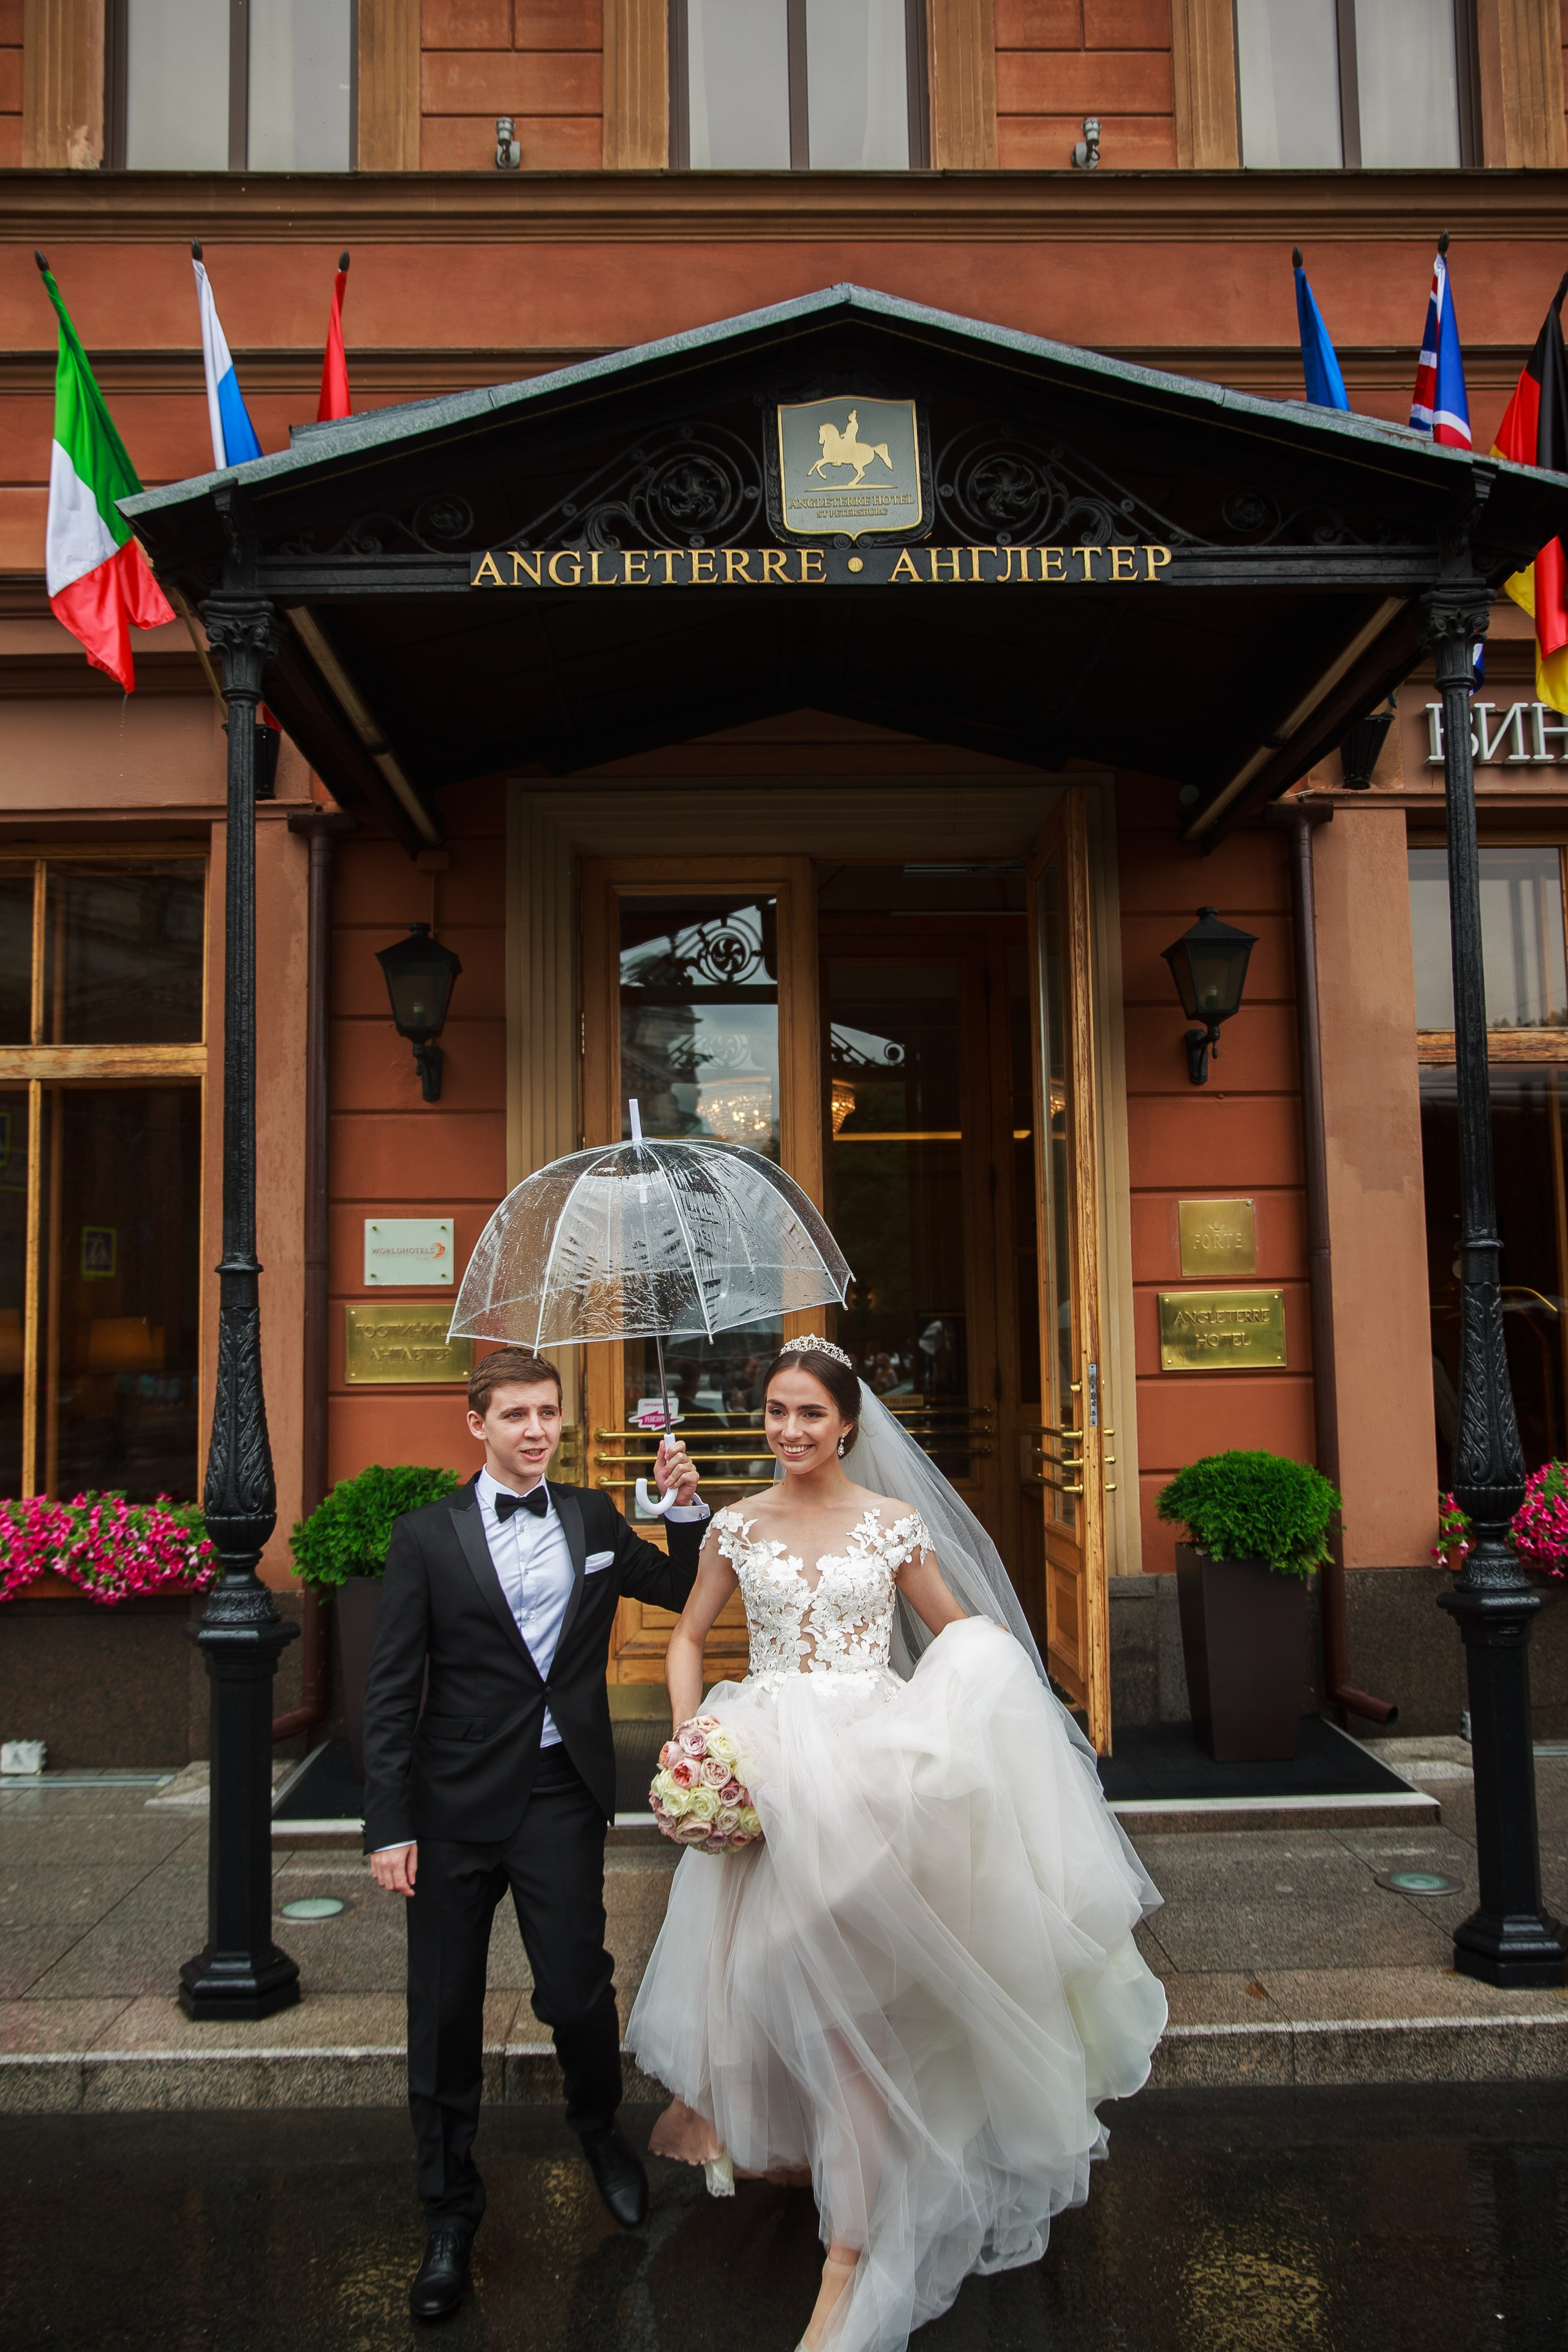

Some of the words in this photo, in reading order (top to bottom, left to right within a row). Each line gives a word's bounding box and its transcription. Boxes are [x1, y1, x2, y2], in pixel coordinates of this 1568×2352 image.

[789, 497, 871, 510] ANGLETERRE
[872, 494, 916, 507] HOTEL
[816, 510, 828, 518] ST
[829, 508, 888, 518] PETERSBURG
[470, 549, 827, 586] ANGLETERRE
[887, 545, 1173, 583] АНГЛЕТЕР
[1193, 1232, 1243, 1250] FORTE
[1174, 1308, 1270, 1325] ANGLETERRE
[1195, 1332, 1252, 1348] HOTEL
[368, 1348, 452, 1362] АНГЛЕТЕР
